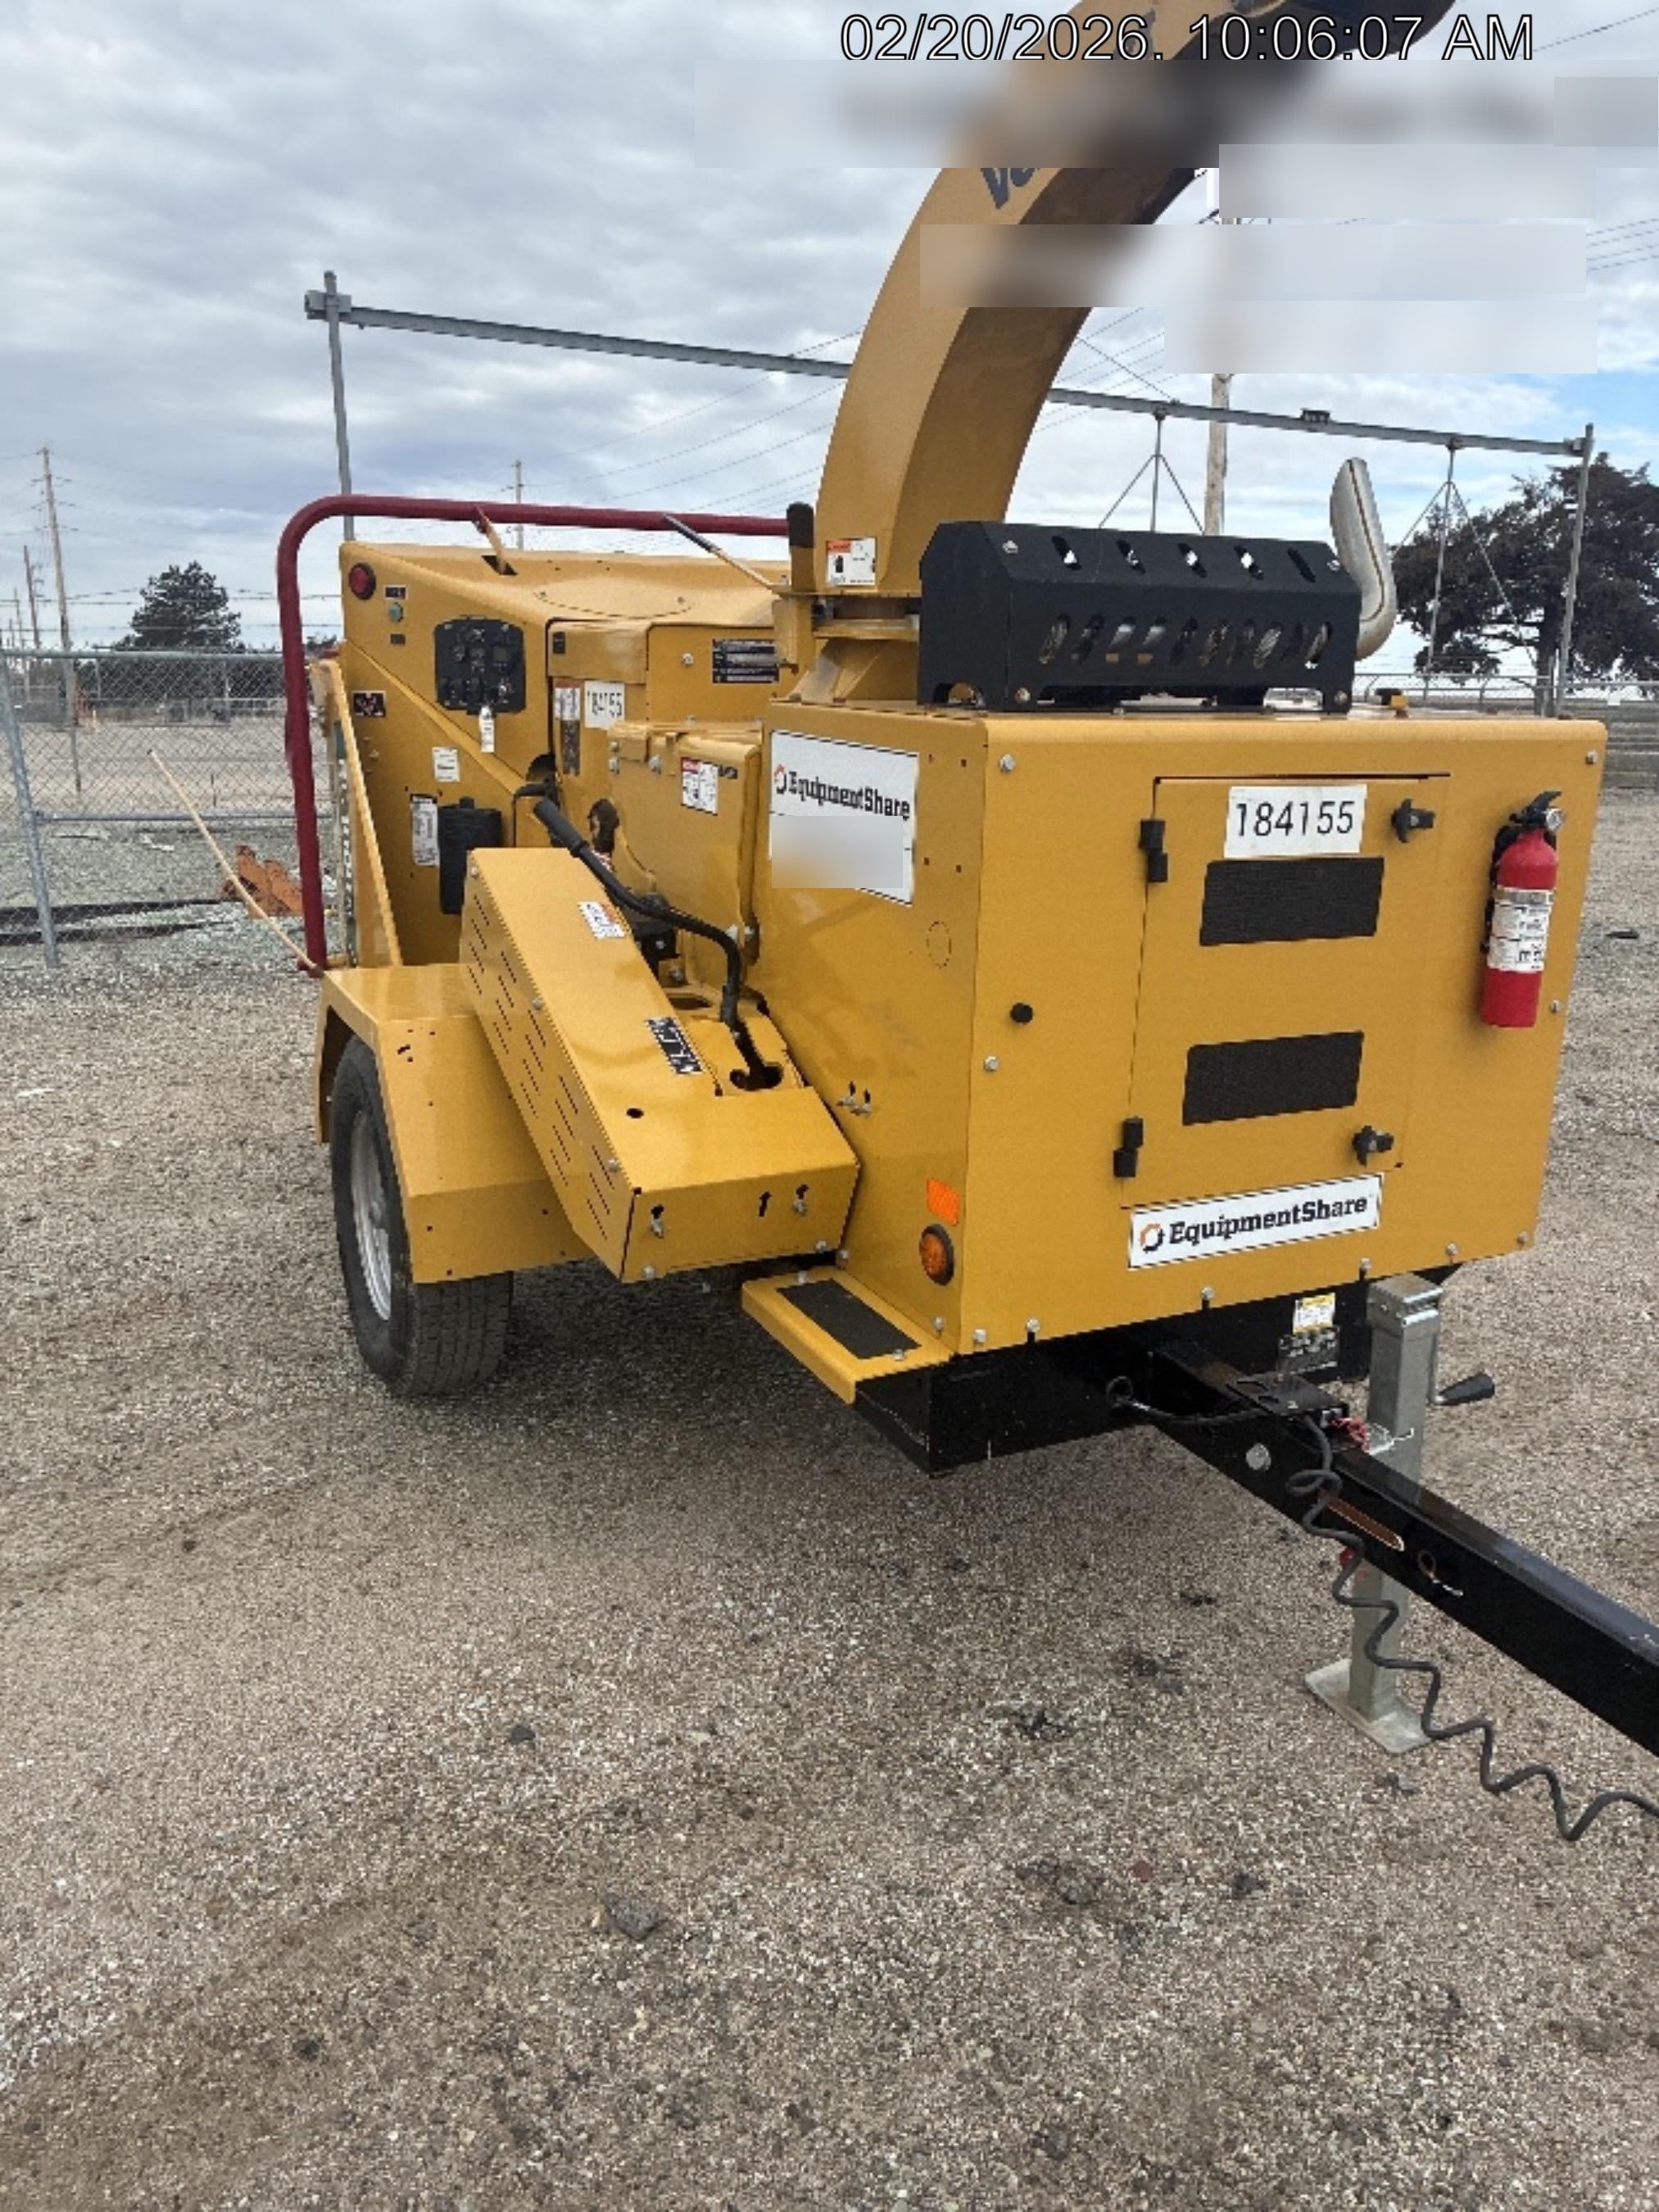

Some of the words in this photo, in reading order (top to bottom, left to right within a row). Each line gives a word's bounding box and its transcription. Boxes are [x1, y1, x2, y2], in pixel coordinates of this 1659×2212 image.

[789, 771, 910, 822] EquipmentShare
[1236, 800, 1355, 836] 184155
[1169, 1196, 1367, 1245] EquipmentShare
